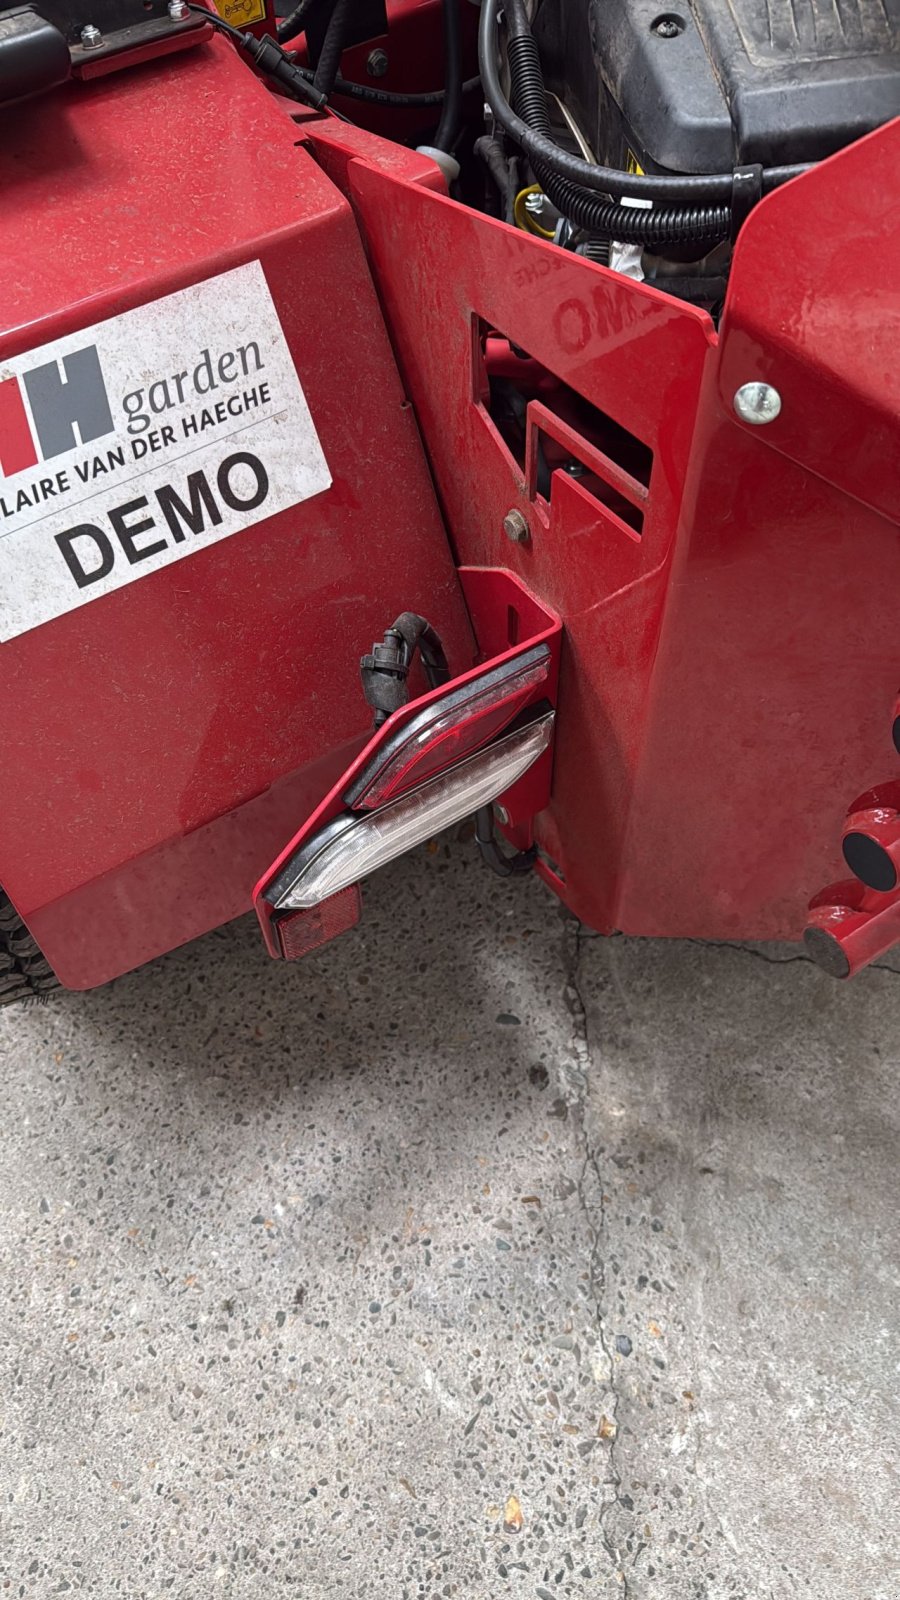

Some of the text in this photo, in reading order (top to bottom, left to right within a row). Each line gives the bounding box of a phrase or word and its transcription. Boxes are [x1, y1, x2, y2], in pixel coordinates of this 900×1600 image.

[0, 382, 272, 518] LAIRE VAN DER HAEGHE
[122, 341, 265, 435] garden
[53, 451, 269, 589] DEMO
